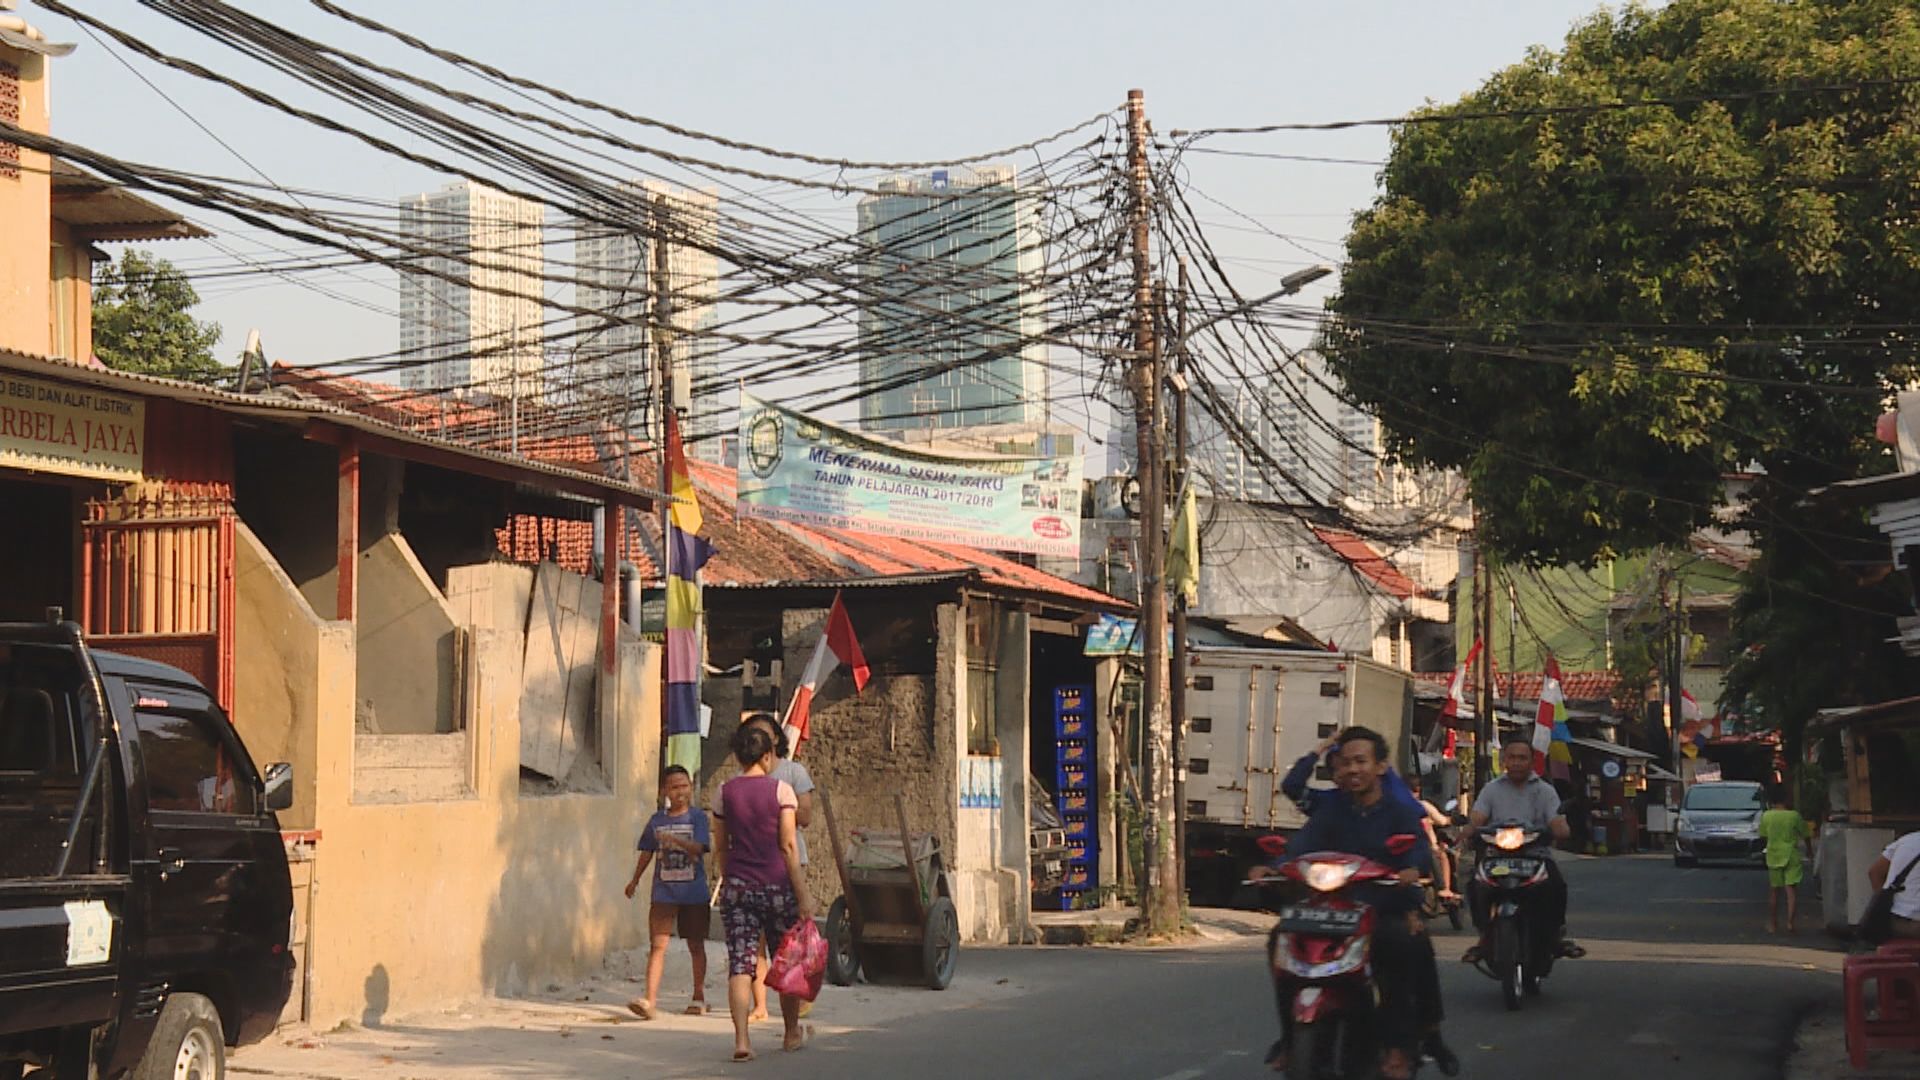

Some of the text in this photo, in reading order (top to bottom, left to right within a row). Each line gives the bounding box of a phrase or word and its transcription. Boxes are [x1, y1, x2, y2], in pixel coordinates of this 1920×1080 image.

[9, 382, 35, 400] BESI
[38, 387, 61, 405] DAN
[64, 392, 92, 408] ALAT
[94, 398, 133, 416] LISTRIK
[0, 406, 138, 455] RBELA JAYA
[808, 448, 900, 477] MENERIMA
[905, 466, 957, 486] SISWA
[959, 475, 1004, 491] BARU
[814, 470, 855, 487] TAHUN
[857, 477, 929, 500] PELAJARAN
[932, 488, 994, 508] 2017/2018
